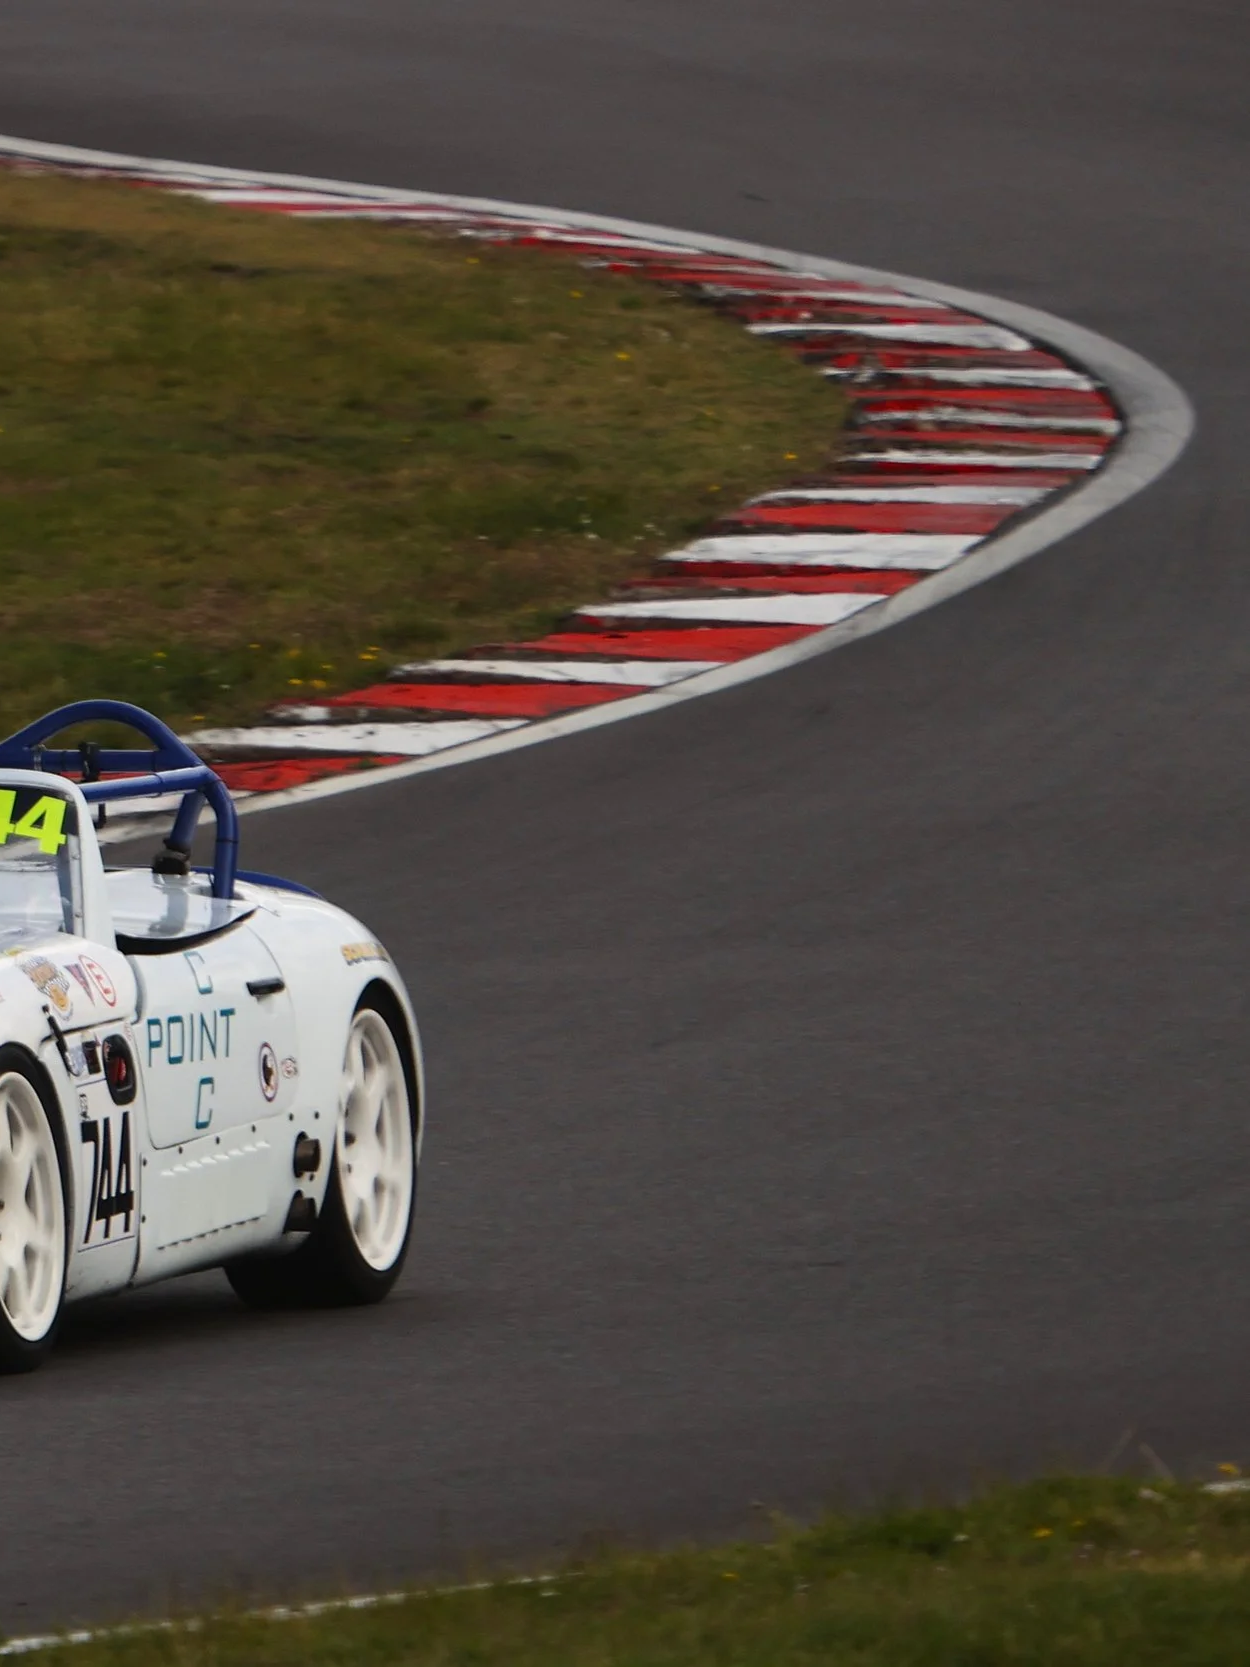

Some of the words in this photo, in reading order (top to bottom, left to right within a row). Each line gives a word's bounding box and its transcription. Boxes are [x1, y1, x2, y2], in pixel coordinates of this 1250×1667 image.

[183, 951, 214, 994] C
[147, 1007, 236, 1068] POINT
[195, 1076, 215, 1129] C
[80, 1110, 135, 1244] 744
